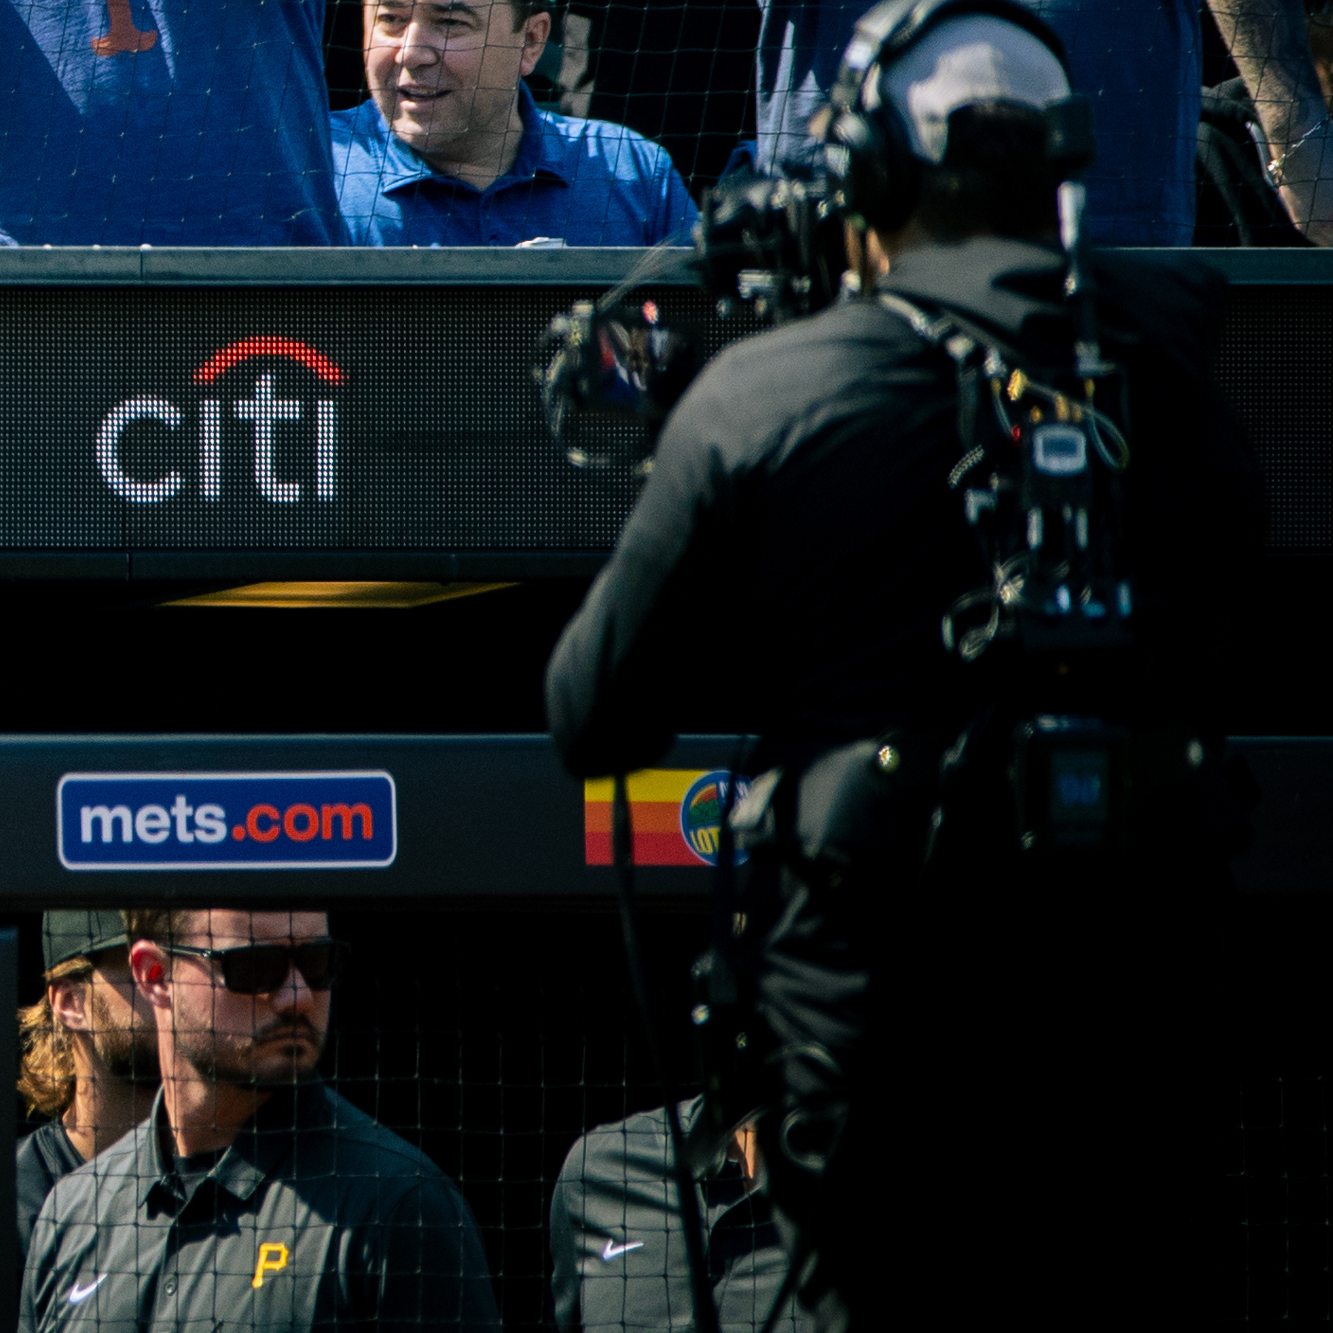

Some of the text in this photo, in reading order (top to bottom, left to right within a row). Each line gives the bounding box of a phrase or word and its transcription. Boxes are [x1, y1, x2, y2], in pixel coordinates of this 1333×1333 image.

[95, 372, 337, 503] citi
[80, 794, 374, 845] mets.com
[252, 1242, 289, 1288] P
